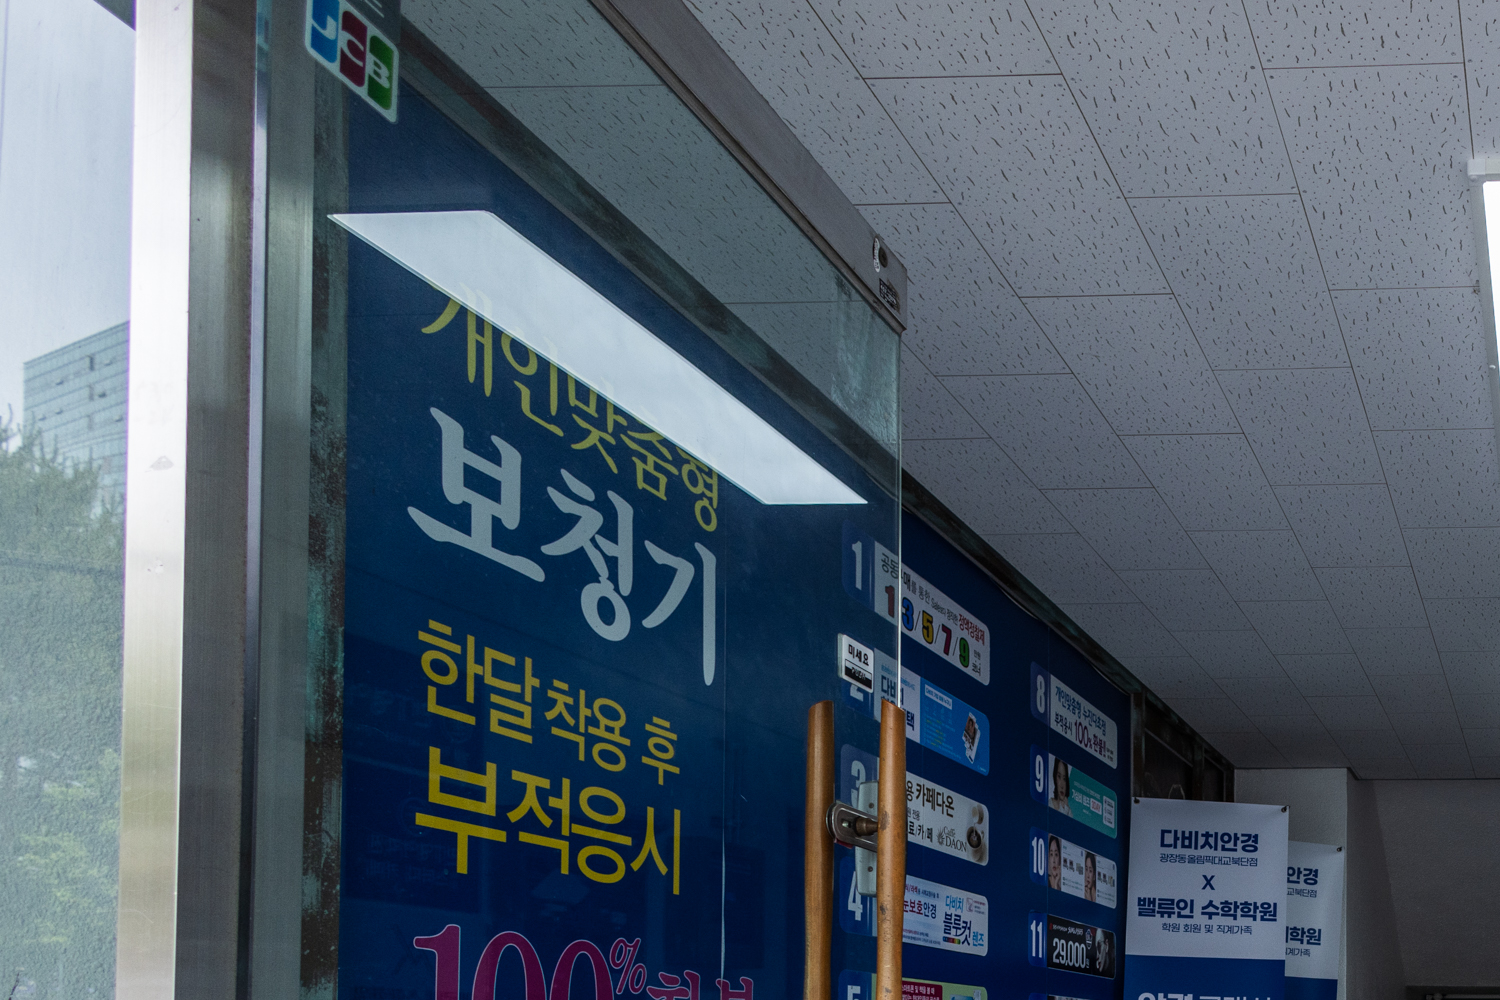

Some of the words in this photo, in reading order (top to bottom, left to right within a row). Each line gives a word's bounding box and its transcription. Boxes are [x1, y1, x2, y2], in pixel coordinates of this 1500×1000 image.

[311, 14, 391, 88] JCB
[407, 406, 719, 686] 보청기
[851, 541, 862, 590] 1
[848, 644, 869, 667] 미세요
[418, 619, 541, 745] 한달
[545, 679, 631, 773] 착용
[641, 716, 681, 786] 후
[1036, 674, 1045, 714] 8
[1055, 686, 1082, 719] 개인맞춤형
[1055, 711, 1073, 736] 부적응시
[1074, 720, 1093, 750] 100%
[1035, 755, 1044, 792] 9
[915, 783, 955, 818] 카페다온
[415, 746, 682, 896] 부적응시
[1032, 837, 1045, 876] 10
[1160, 828, 1259, 853] 다비치안경
[848, 871, 863, 921] 4
[1201, 874, 1216, 891] X
[945, 895, 964, 913] 다비치
[1137, 896, 1194, 919] 밸류인
[1201, 899, 1278, 922] 수학학원
[1030, 920, 1042, 958] 11
[1161, 922, 1180, 933] 학원
[1183, 923, 1201, 934] 회원
[1204, 923, 1214, 934] 및
[1216, 923, 1253, 935] 직계가족
